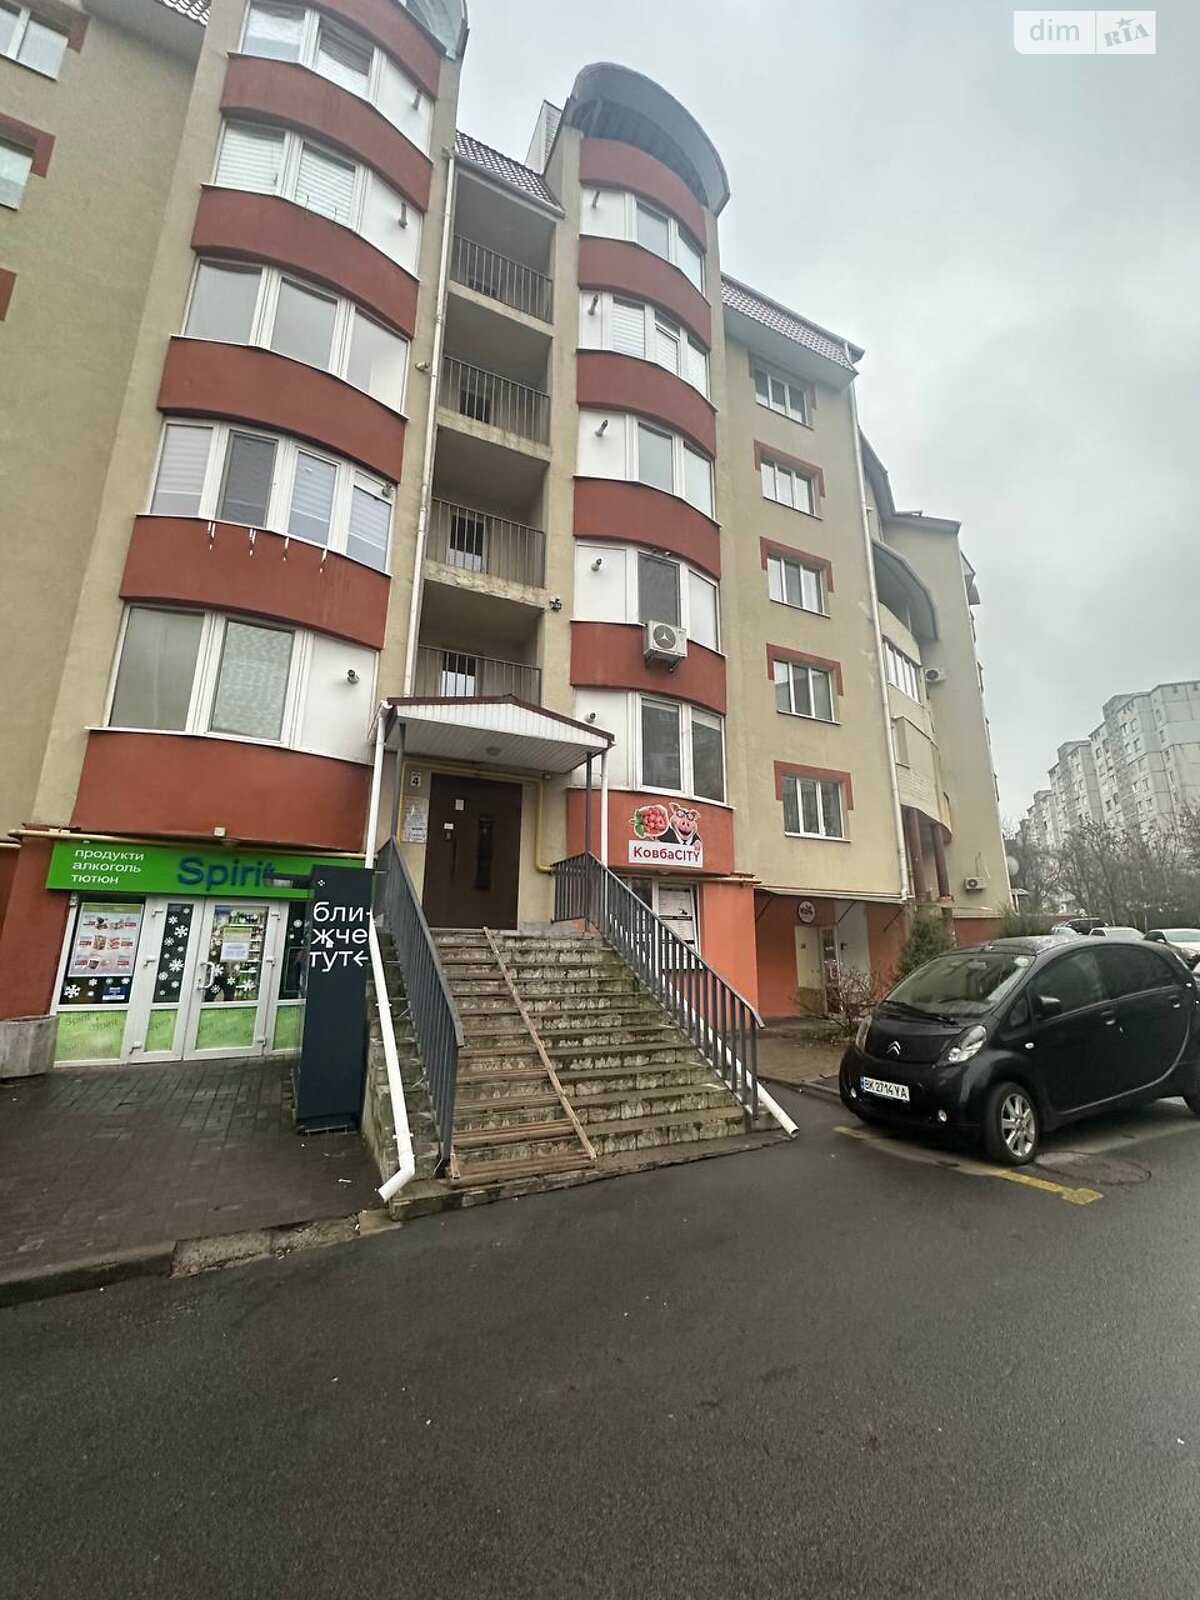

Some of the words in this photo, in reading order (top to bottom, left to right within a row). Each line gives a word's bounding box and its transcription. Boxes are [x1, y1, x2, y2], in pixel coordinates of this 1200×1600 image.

[74, 849, 145, 861] продукти
[72, 862, 141, 873] алкоголь
[71, 874, 119, 884] тютюн
[311, 928, 368, 945] жче
[309, 951, 353, 973] тут
